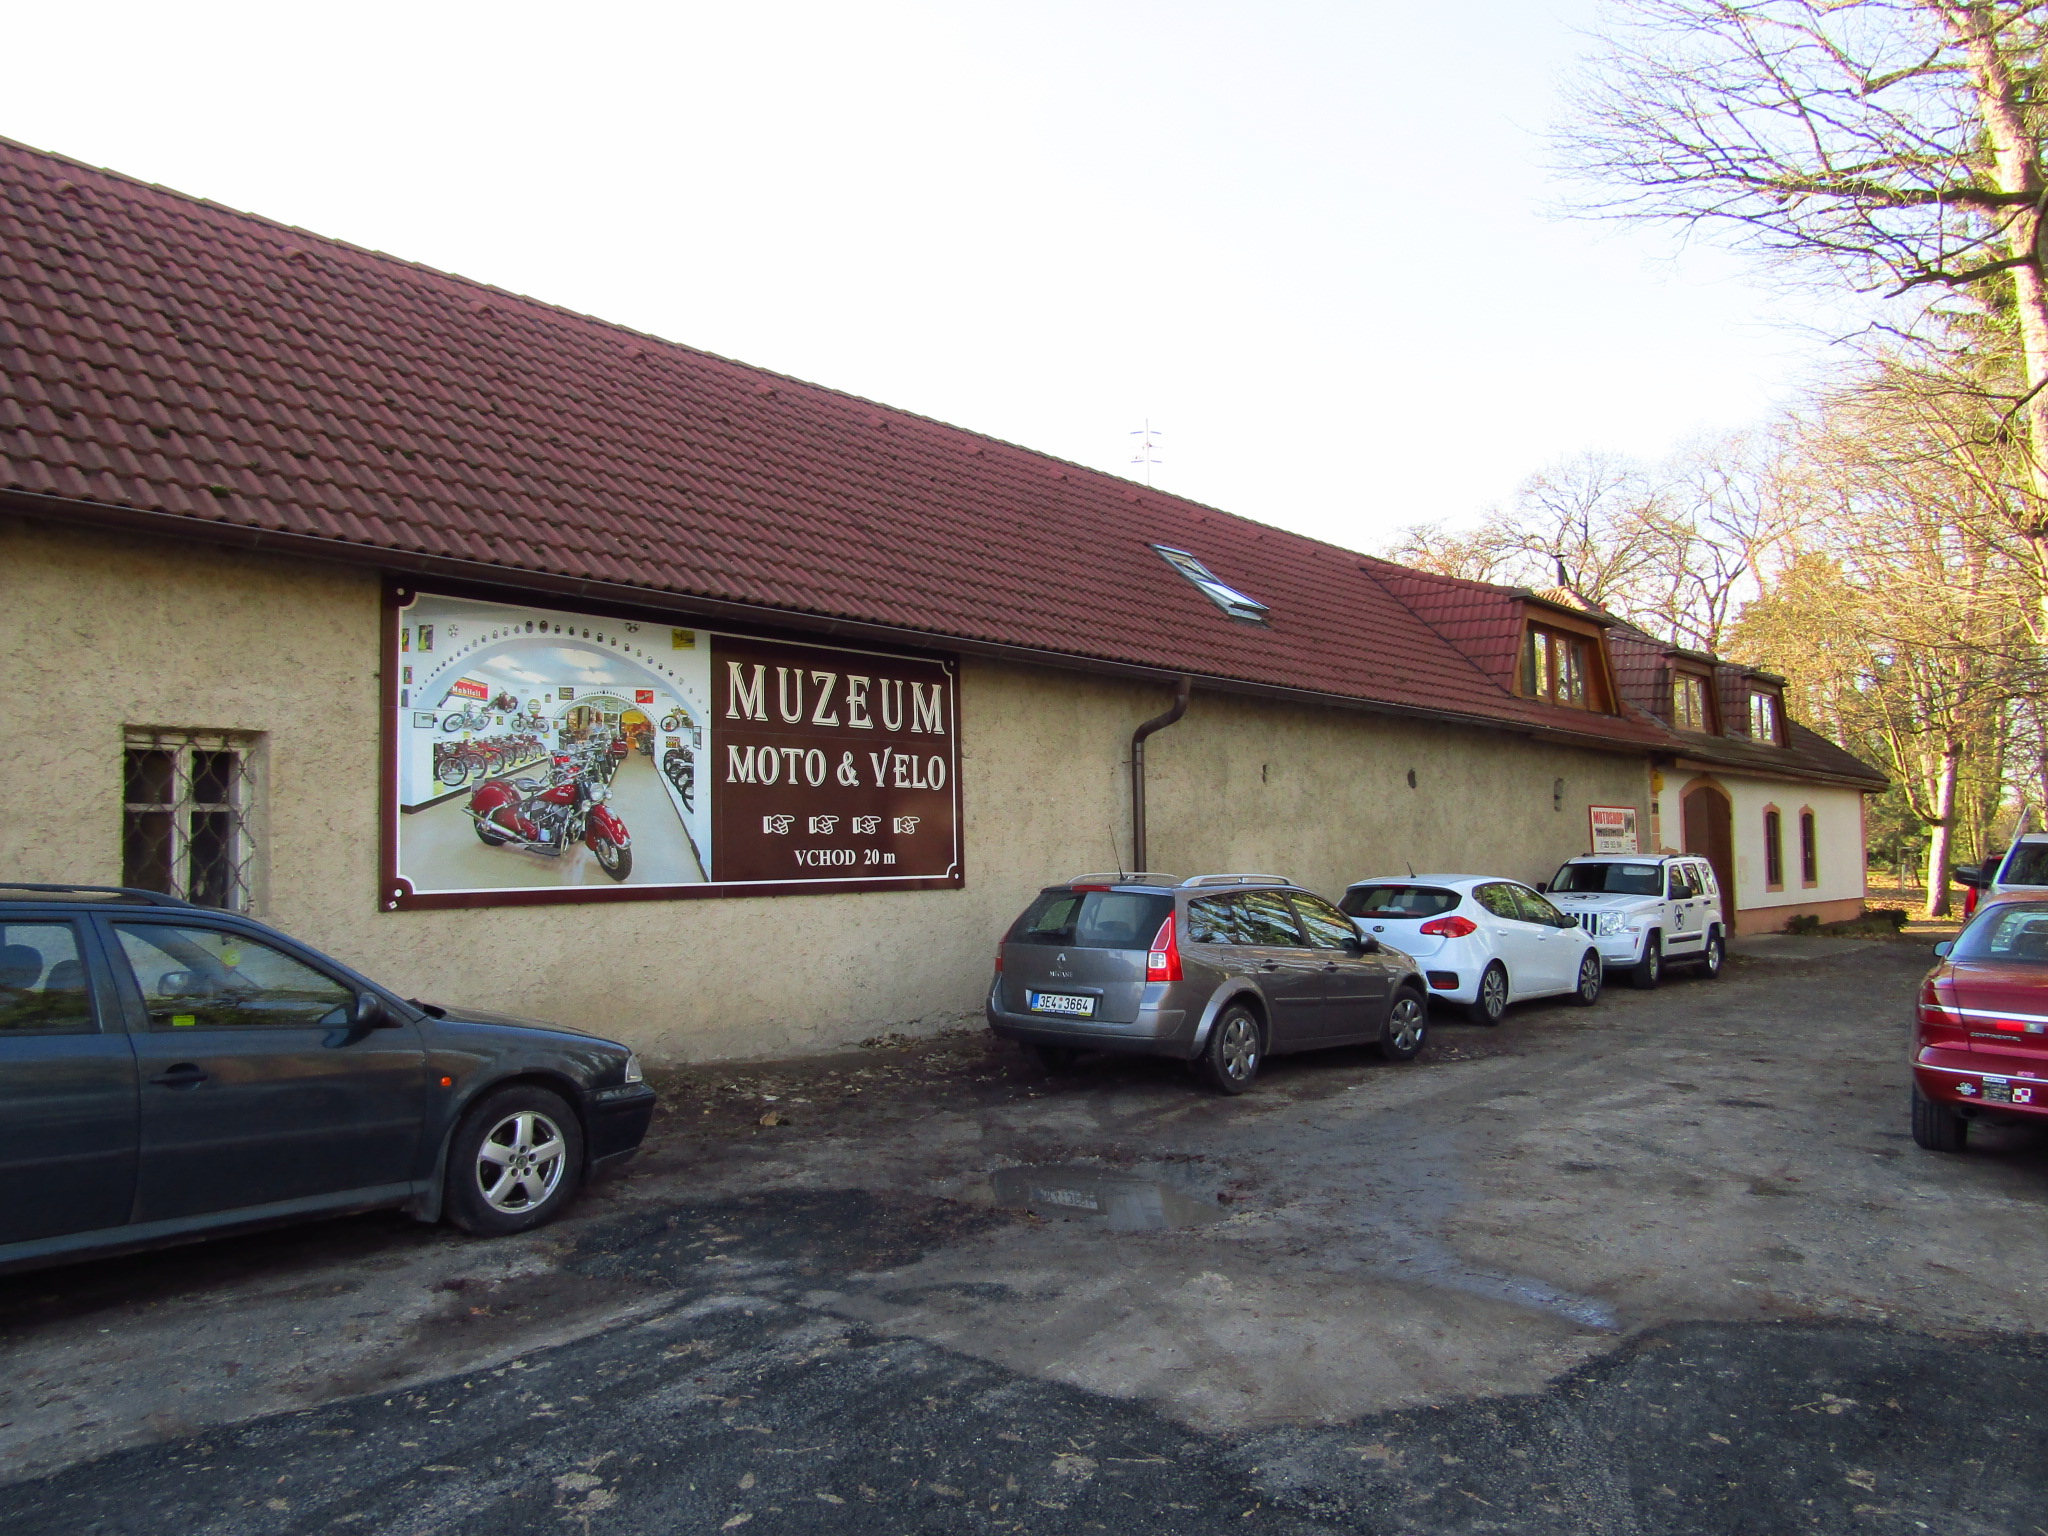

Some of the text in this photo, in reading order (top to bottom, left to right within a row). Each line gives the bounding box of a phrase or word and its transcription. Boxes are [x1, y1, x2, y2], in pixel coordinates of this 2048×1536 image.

[726, 661, 945, 734] MUZEUM
[726, 745, 946, 790] MOTO & VELO
[794, 848, 897, 867] VCHOD 20 m
[1040, 995, 1056, 1009] 3E4
[1063, 997, 1088, 1012] 3664
